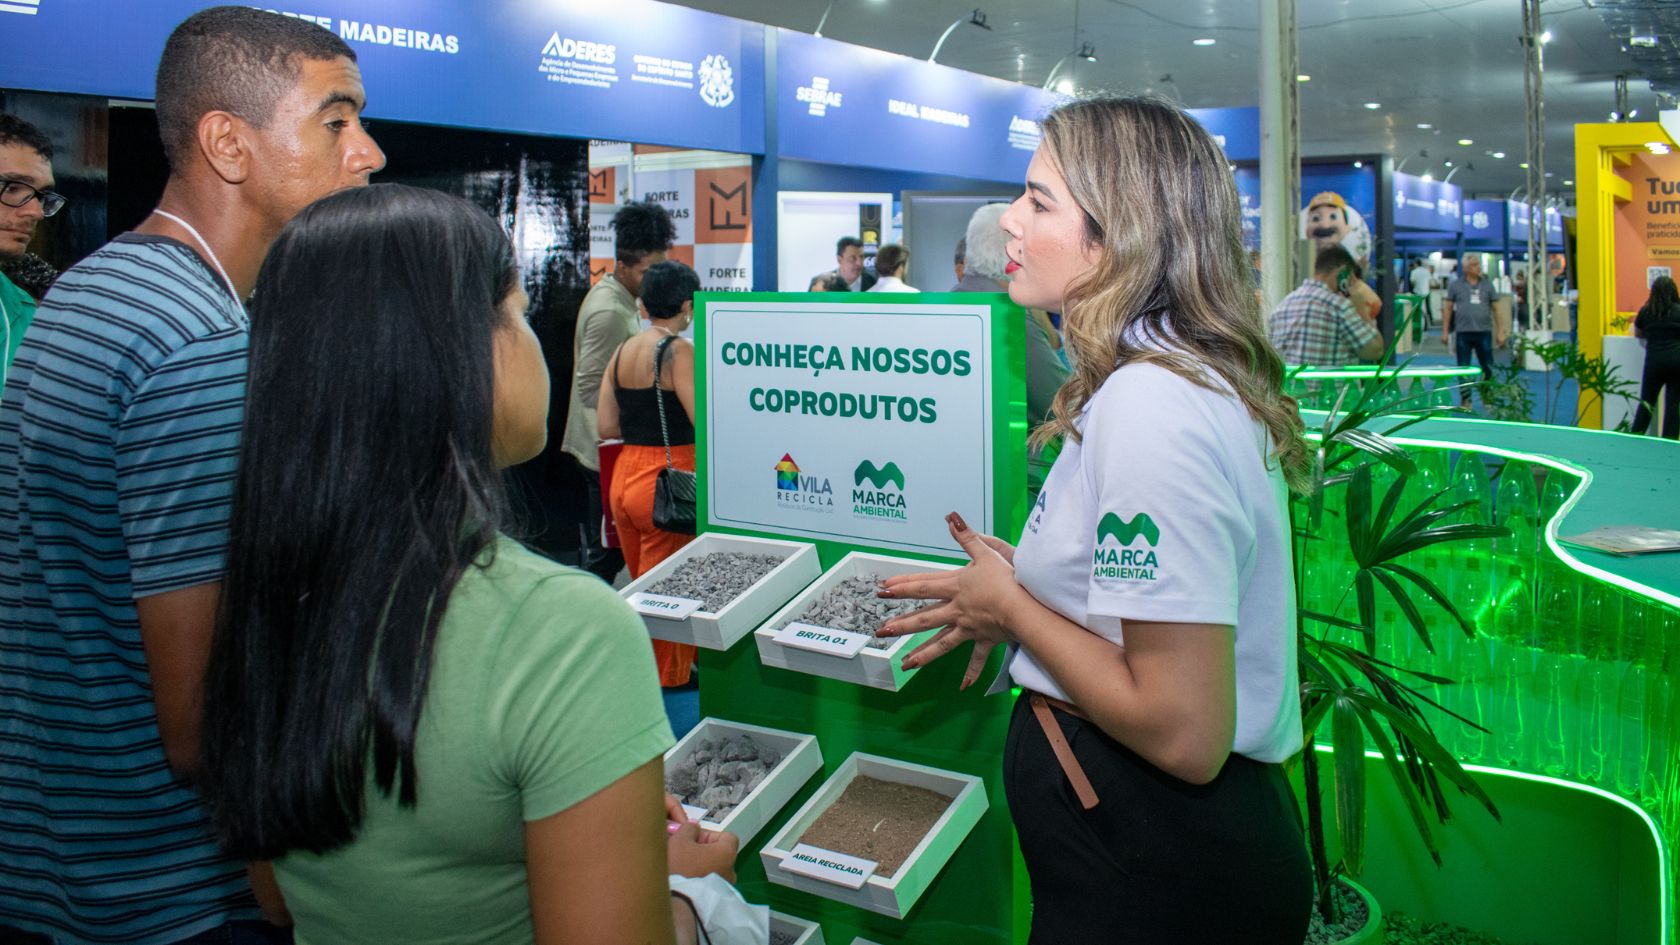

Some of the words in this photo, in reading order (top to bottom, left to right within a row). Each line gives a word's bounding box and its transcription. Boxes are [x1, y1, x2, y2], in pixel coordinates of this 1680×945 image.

[339, 19, 460, 54] MADEIRAS
[541, 31, 616, 64] ADERES
[796, 86, 842, 108] SEBRAE
[888, 98, 920, 119] IDEAL
[645, 191, 679, 202] FORTE
[709, 267, 746, 279] FORTE
[721, 342, 845, 377] CONHEÇA
[851, 346, 972, 377] NOSSOS
[749, 387, 938, 424] COPRODUTOS
[800, 475, 833, 495] VILA
[777, 491, 834, 506] RECICLA
[852, 489, 907, 509] MARCA
[853, 505, 907, 520] AMBIENTAL
[1093, 548, 1159, 568] MARCA
[1093, 567, 1157, 580] AMBIENTAL
[640, 599, 671, 610] BRITA
[796, 629, 830, 643] BRITA
[831, 636, 848, 646] 01
[793, 854, 818, 865] AREIA
[818, 858, 863, 876] RECICLADA
